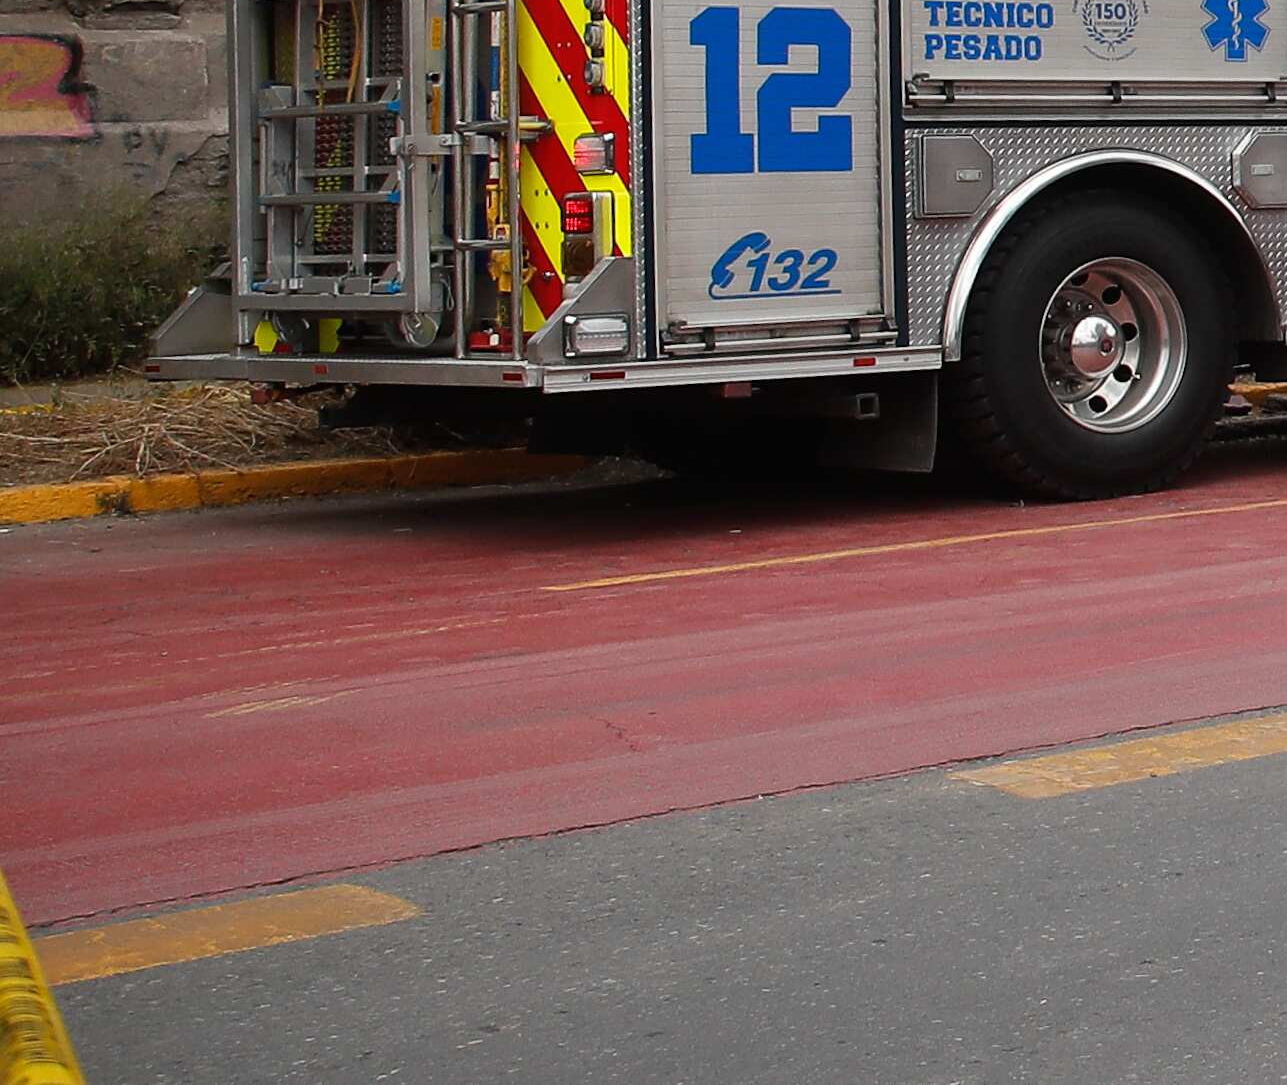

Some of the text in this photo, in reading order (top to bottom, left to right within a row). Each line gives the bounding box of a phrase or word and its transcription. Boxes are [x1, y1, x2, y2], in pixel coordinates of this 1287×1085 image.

[923, 0, 1054, 28] TECNICO
[1095, 3, 1126, 20] 150
[924, 34, 1042, 61] PESADO
[689, 6, 852, 175] 12
[745, 249, 839, 291] 132
